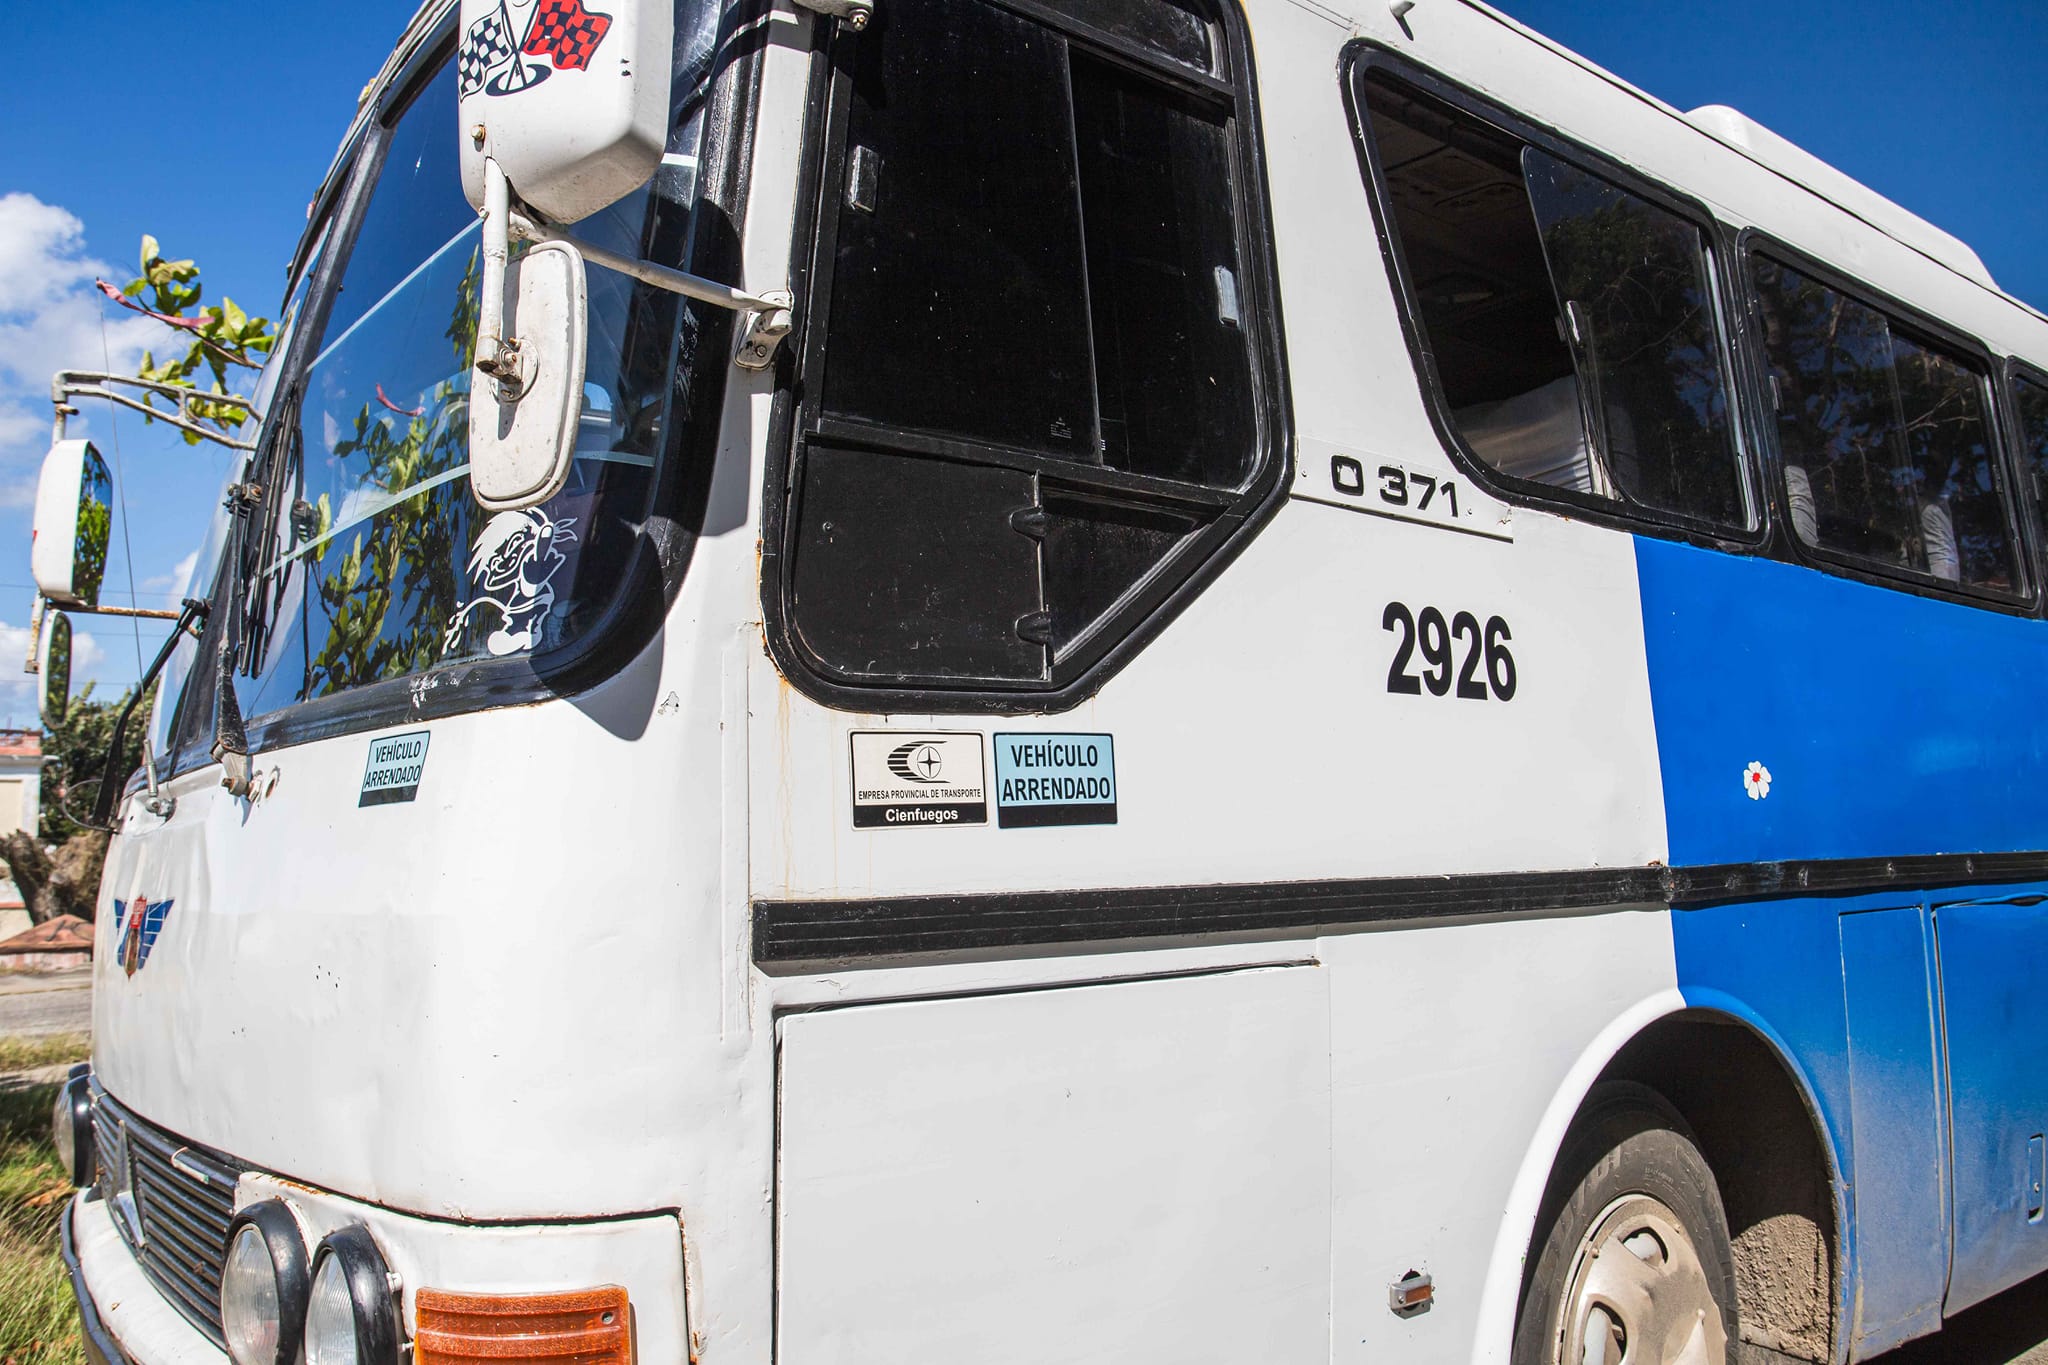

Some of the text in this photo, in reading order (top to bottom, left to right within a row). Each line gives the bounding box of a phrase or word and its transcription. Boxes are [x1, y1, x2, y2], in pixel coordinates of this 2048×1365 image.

[1378, 465, 1458, 517] 371
[1382, 601, 1517, 702] 2926
[375, 740, 421, 763] VEHÍCULO
[1011, 740, 1098, 767] VEHÍCULO
[364, 764, 421, 788] ARRENDADO
[858, 788, 981, 800] EMPRESA PROVINCIAL DE TRANSPORTE
[1003, 777, 1110, 801] ARRENDADO
[885, 808, 958, 823] Cienfuegos
